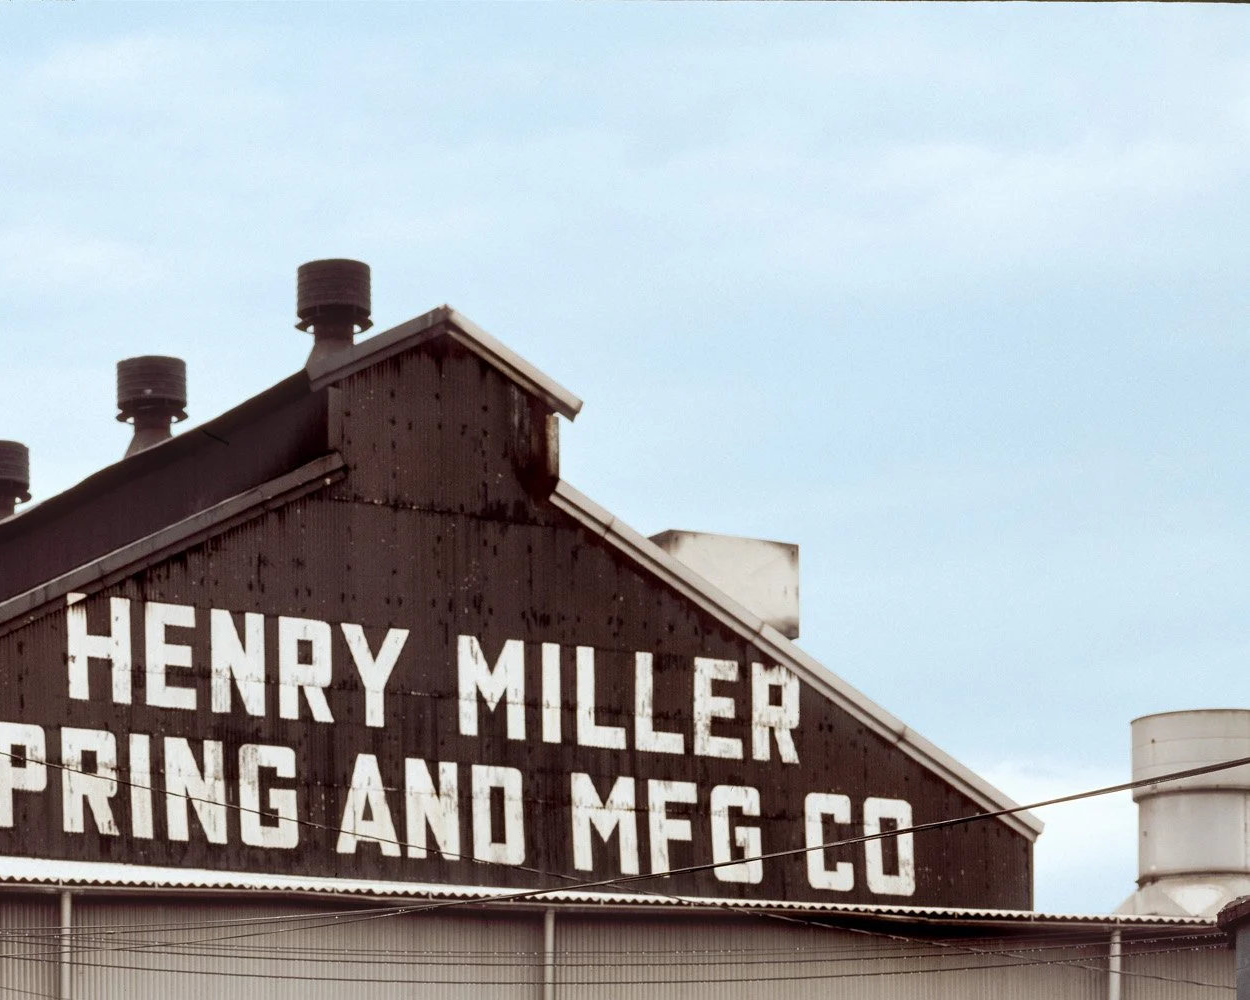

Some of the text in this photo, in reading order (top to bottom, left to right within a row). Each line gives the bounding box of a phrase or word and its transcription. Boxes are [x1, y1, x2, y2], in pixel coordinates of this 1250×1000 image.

[66, 593, 800, 765] HENRY MILLER
[336, 753, 526, 866] AND
[571, 772, 763, 885] MFG
[805, 792, 916, 898] CO
